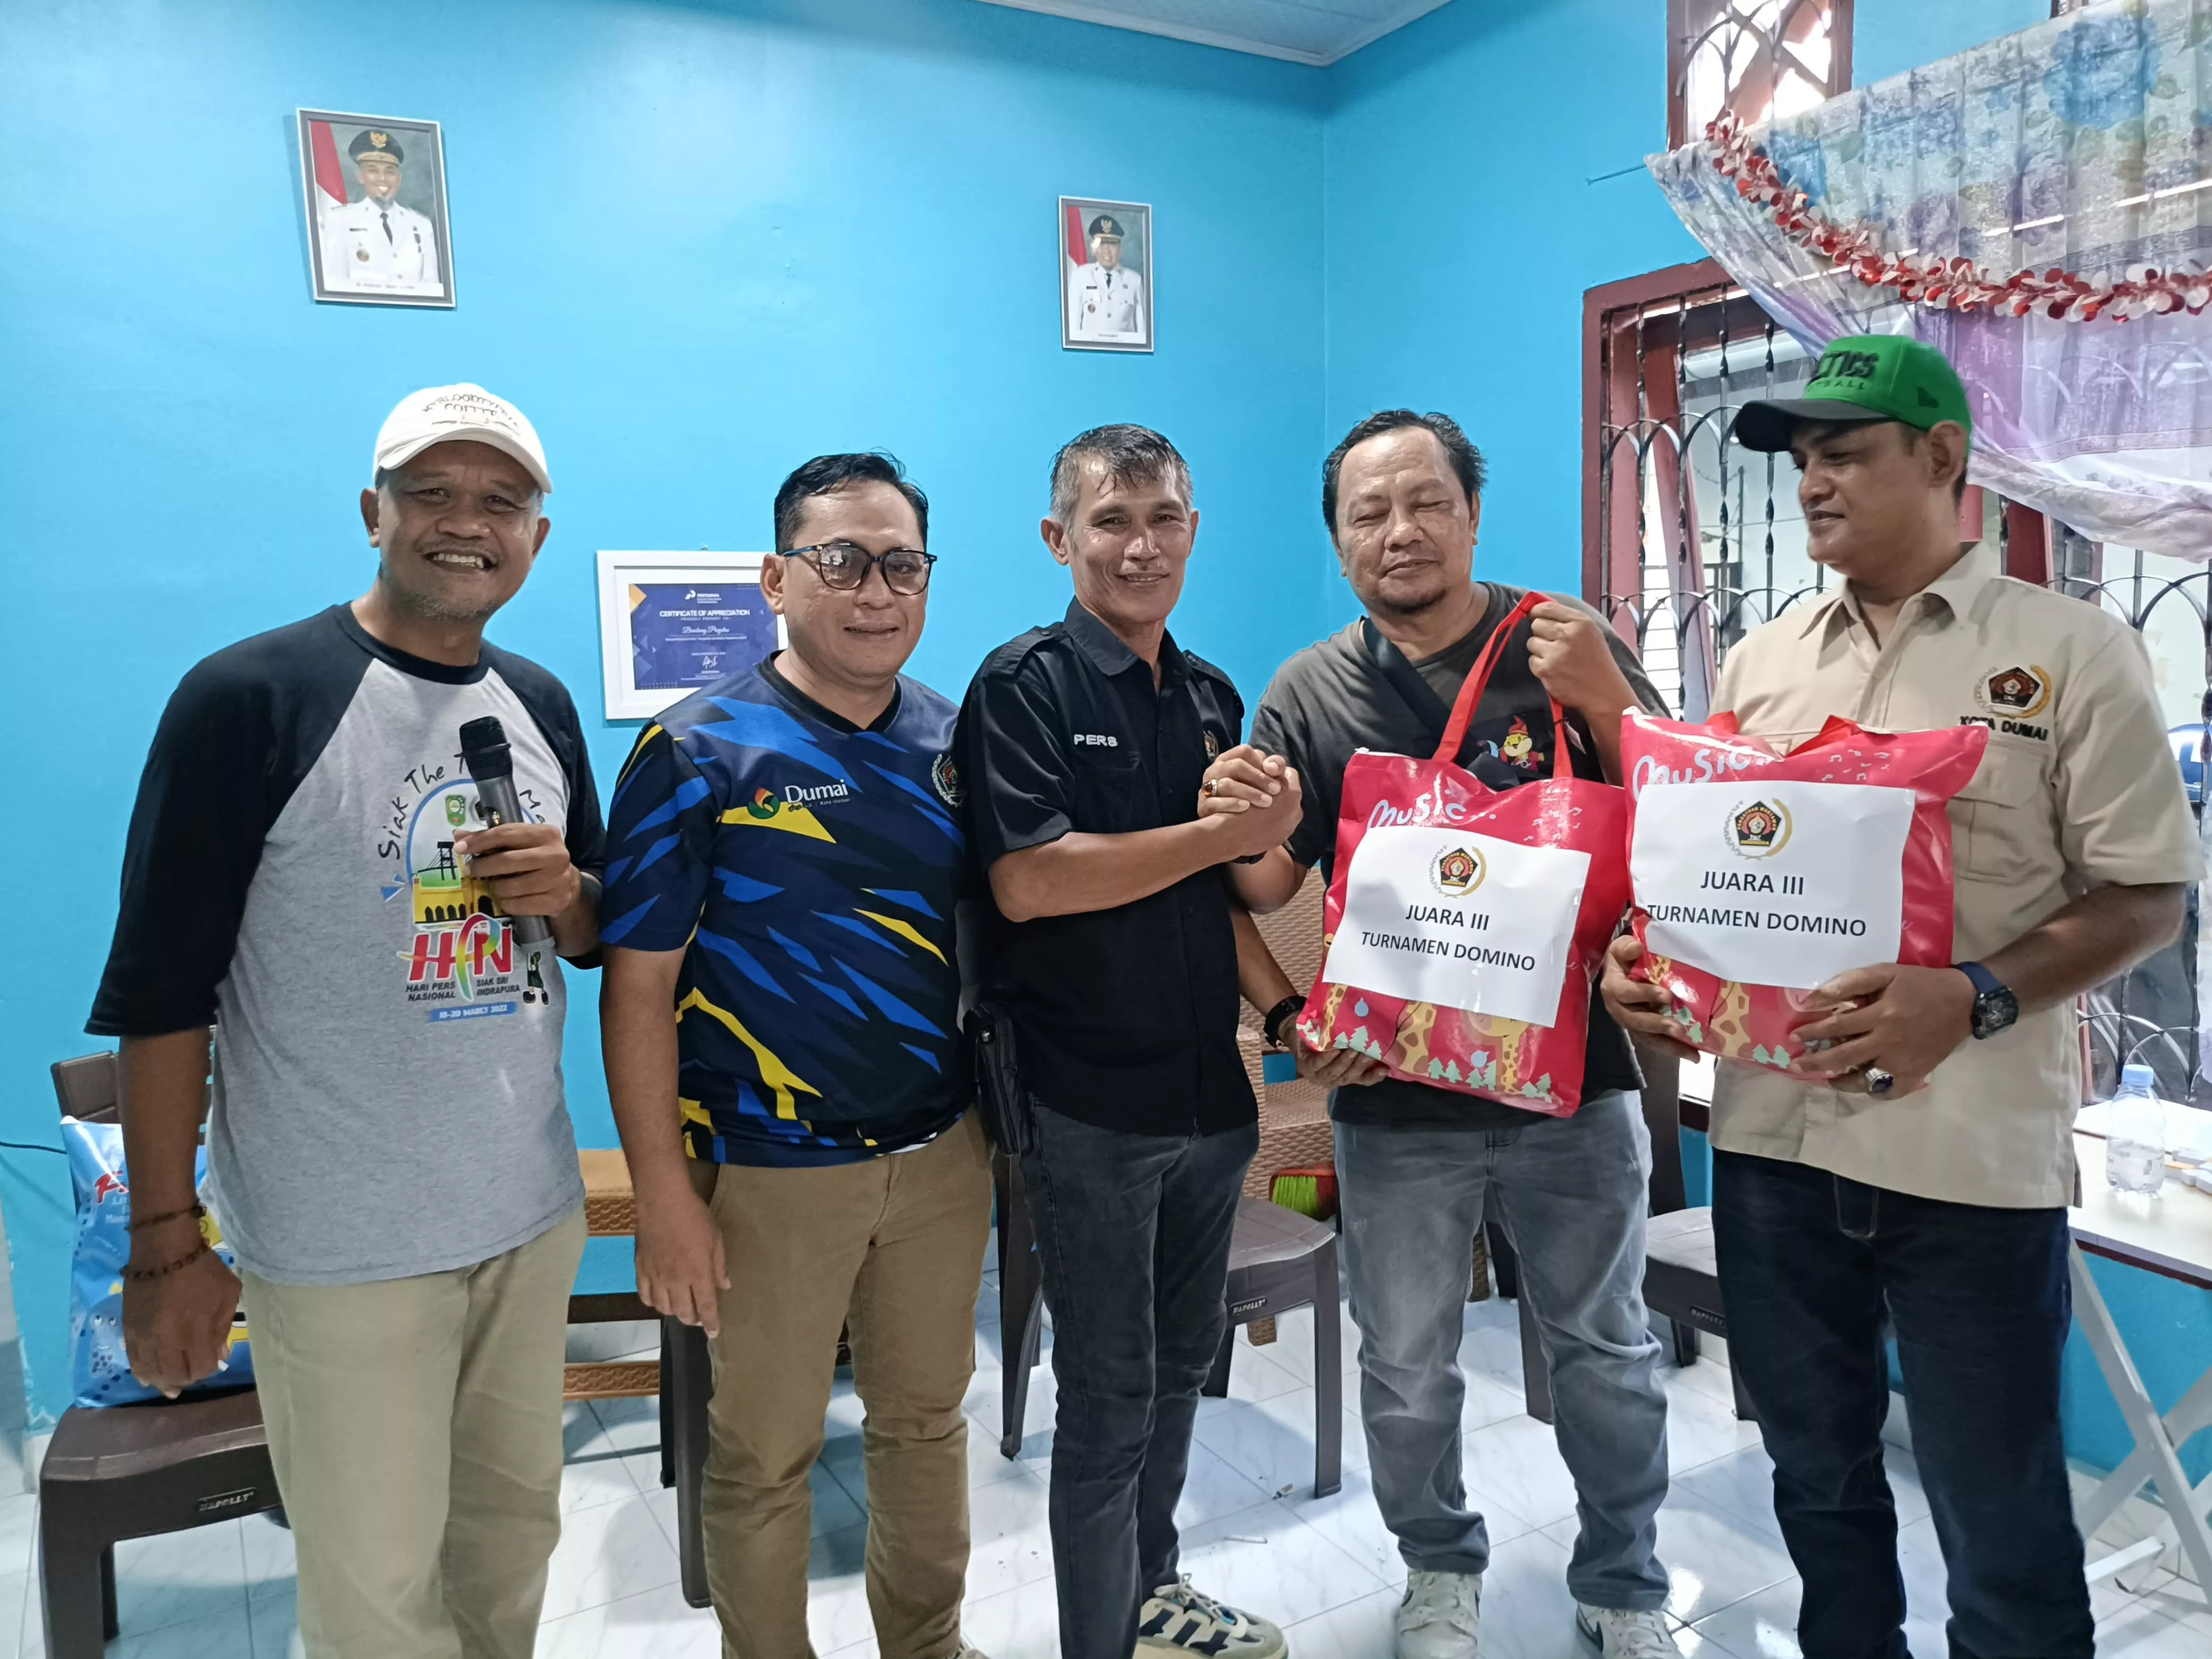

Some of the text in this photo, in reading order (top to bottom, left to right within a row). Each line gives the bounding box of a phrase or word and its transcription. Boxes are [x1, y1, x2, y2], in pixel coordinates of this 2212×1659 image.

[2001, 720, 2048, 741] DUMAI
[785, 778, 848, 803] Dumai
[378, 764, 445, 860] Siak The
[1700, 870, 1805, 895] JUARA III
[1405, 904, 1489, 931] JUARA III
[1647, 904, 1866, 937] TURNAMEN DOMINO
[1361, 931, 1536, 971] TURNAMEN DOMINO
[406, 982, 429, 993] HARI
[476, 977, 494, 987] SIAK
[477, 985, 521, 996] INDRAPURA
[408, 991, 456, 1002] NASIONAL
[463, 1007, 488, 1016] MARET
[490, 1004, 508, 1013] 2022
